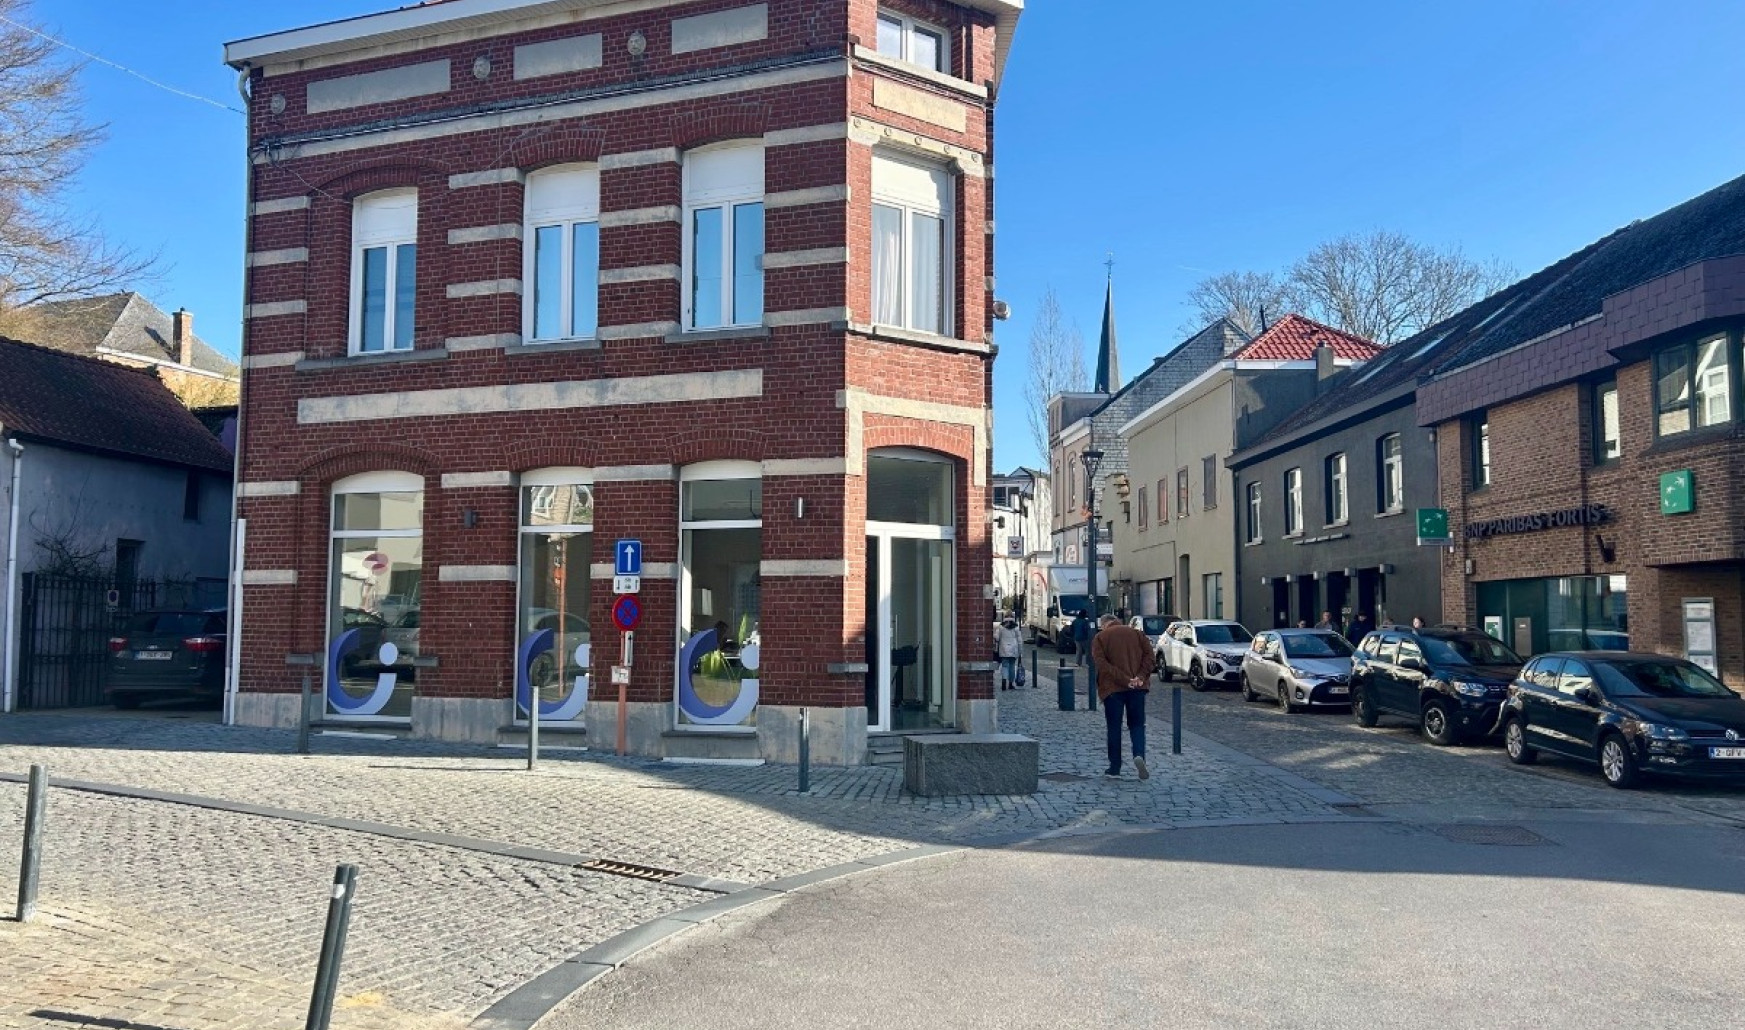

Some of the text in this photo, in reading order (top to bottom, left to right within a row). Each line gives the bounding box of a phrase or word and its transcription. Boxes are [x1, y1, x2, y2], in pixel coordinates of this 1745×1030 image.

[1464, 504, 1601, 538] BNP PARIBAS FORTIS
